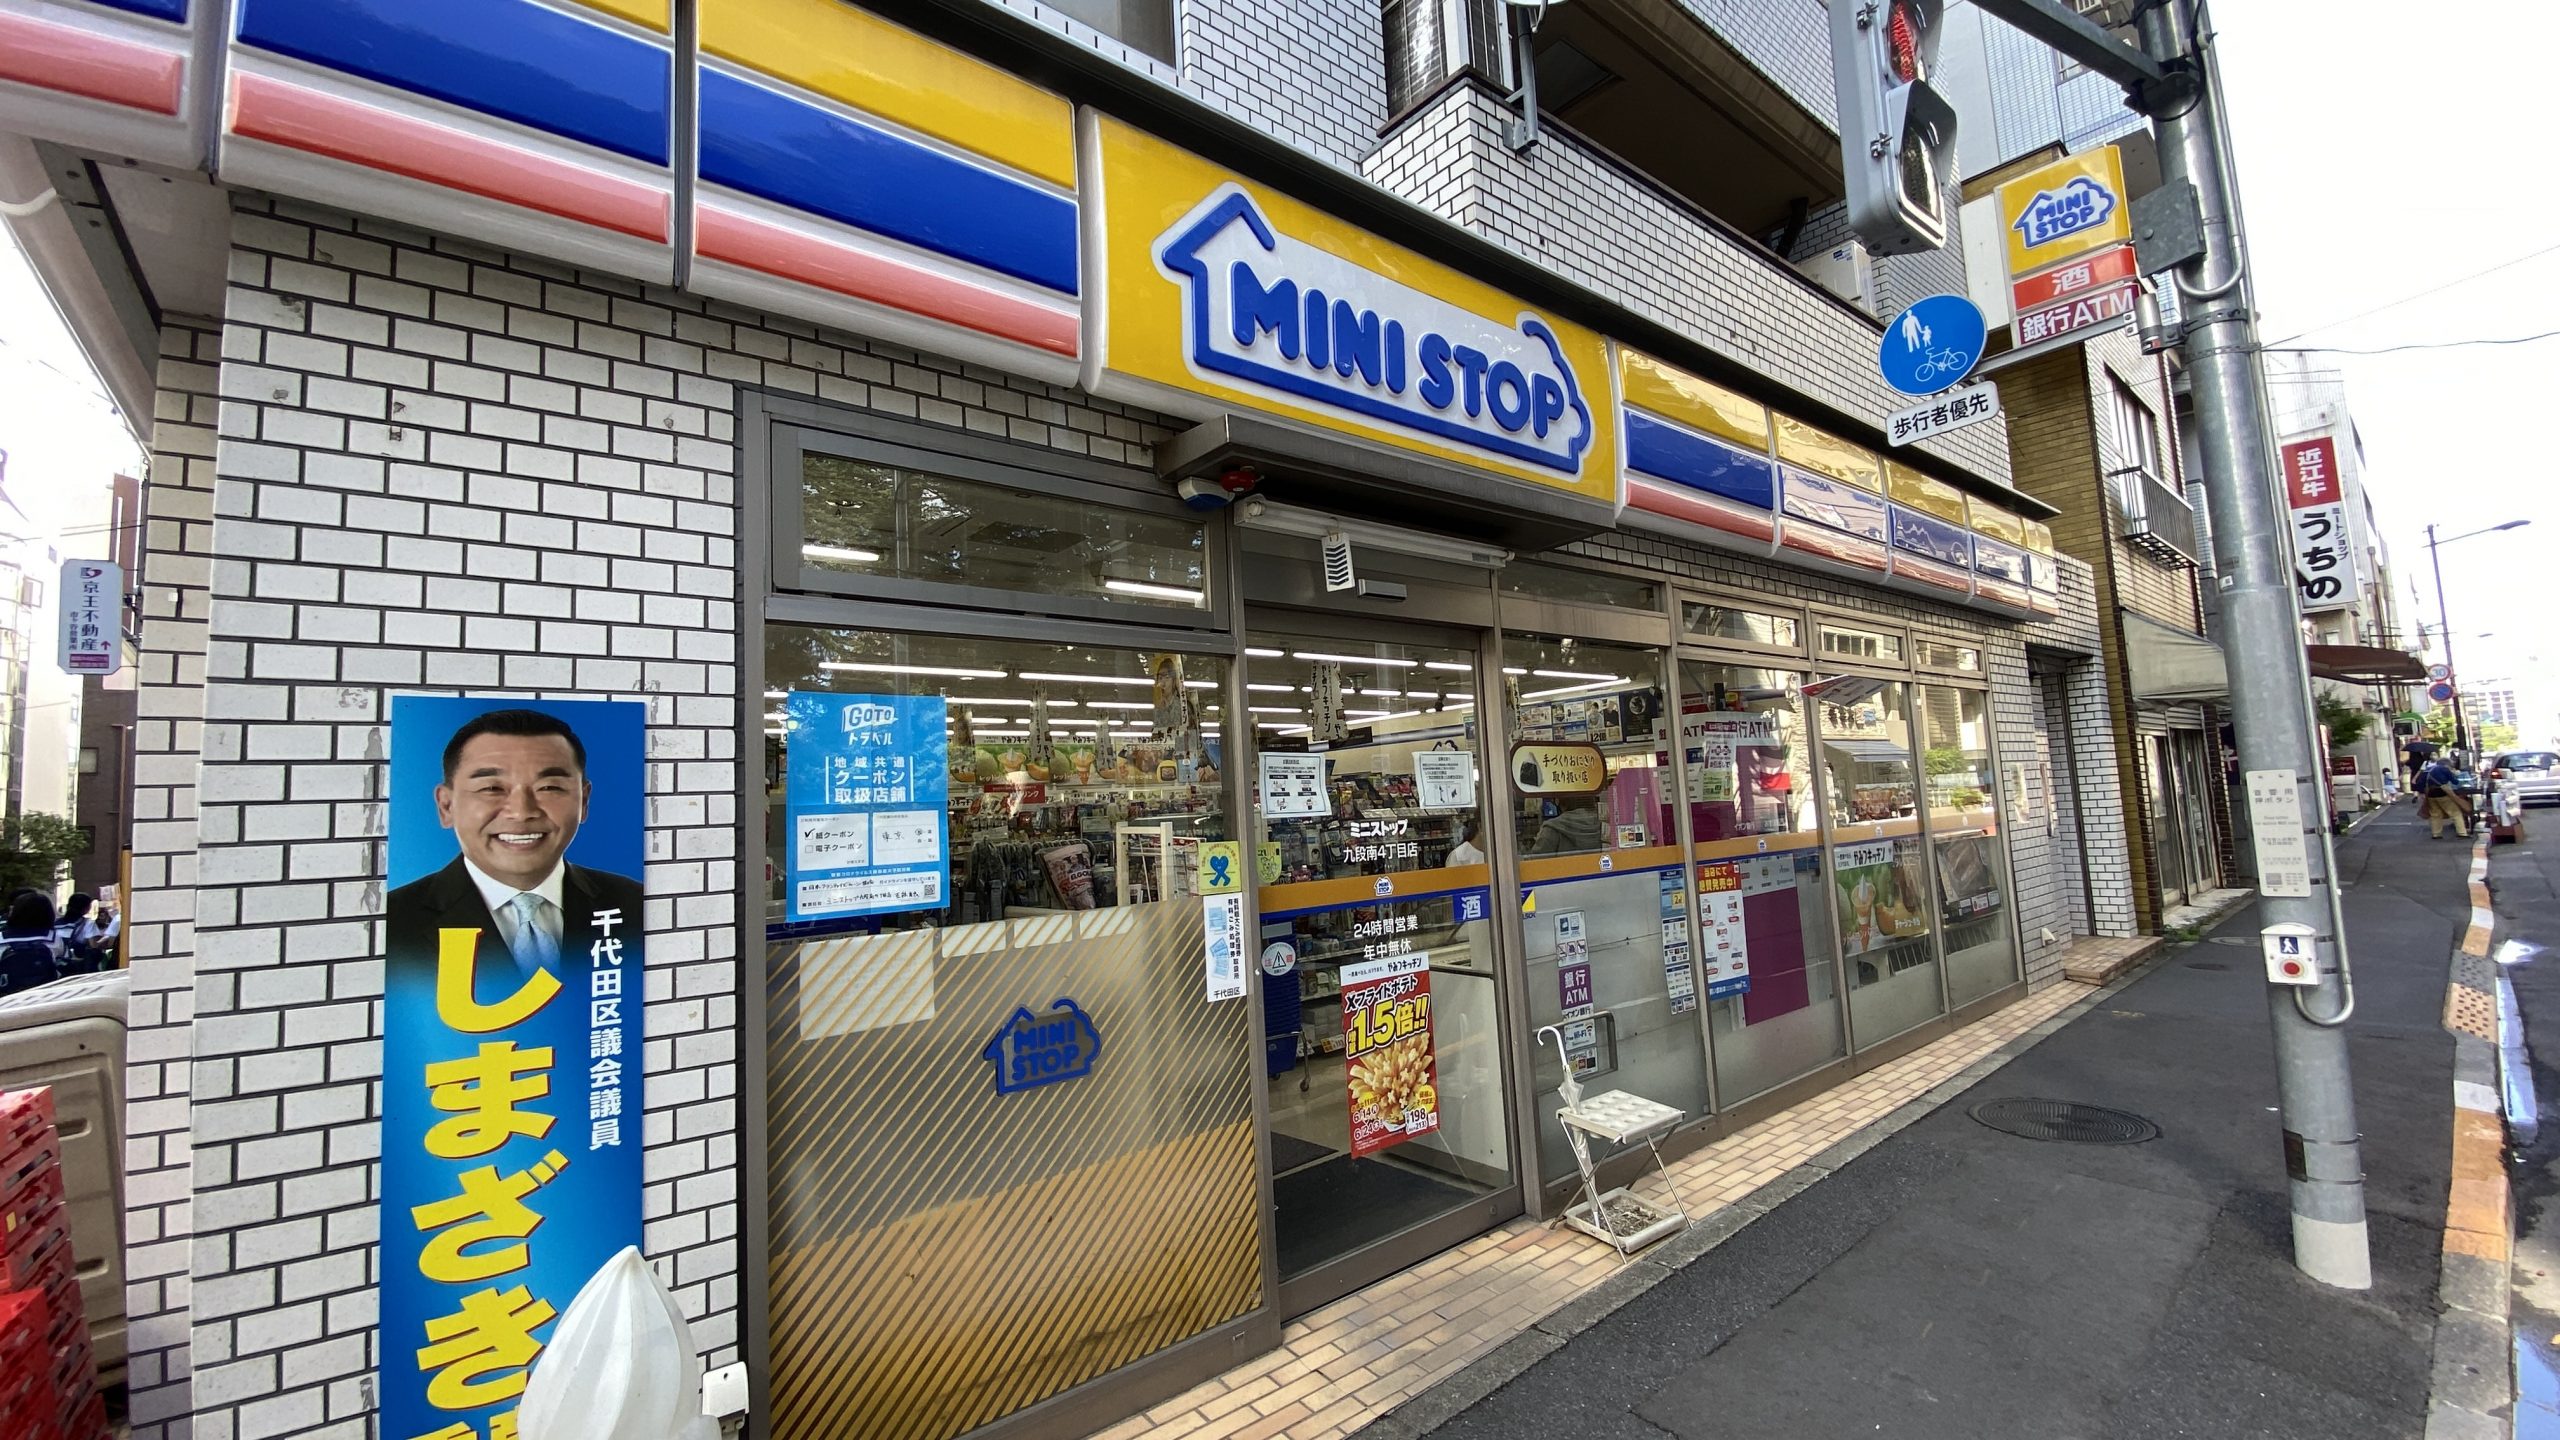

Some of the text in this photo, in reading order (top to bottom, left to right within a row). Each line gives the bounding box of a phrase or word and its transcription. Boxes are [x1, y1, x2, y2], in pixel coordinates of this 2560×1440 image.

[2035, 190, 2091, 222] MINI
[2035, 206, 2096, 239] STOP
[2051, 263, 2090, 295] 酒
[2022, 289, 2134, 343] 銀行ATM
[1231, 260, 1566, 440] MINI STOP
[1893, 394, 1990, 439] 歩行者優先
[2297, 447, 2327, 498] 近江牛
[2332, 507, 2349, 561] ミートショップ
[2299, 511, 2342, 600] うちの
[80, 580, 100, 651] 京王不動産
[2431, 668, 2446, 678] 30
[848, 731, 893, 746] トラベル
[834, 755, 906, 769] 地域共通
[1542, 753, 1595, 768] 手づくりおにぎり
[834, 769, 906, 787] クーポン
[1551, 770, 1589, 784] 取り扱い店
[834, 787, 907, 803] 取扱店舗
[1350, 819, 1409, 838] ミニストップ
[1343, 842, 1418, 863] 九段南4丁目店
[1853, 846, 1886, 866] やみつキッチン
[1704, 866, 1727, 878] 当店にて
[1461, 895, 1482, 920] 酒
[1353, 914, 1419, 938] 24時間営業
[1363, 938, 1412, 961] 年中無休
[1387, 957, 1422, 973] やみつキッチン
[1564, 969, 1586, 988] 銀行
[1213, 986, 1241, 1000] 千代田区
[1565, 987, 1588, 1005] ATM
[589, 908, 624, 1151] 千代田区議会議員
[1013, 1020, 1076, 1054] MINI
[1011, 1043, 1080, 1081] STOP
[1410, 1107, 1426, 1122] 198
[405, 926, 572, 1440] しまざき
